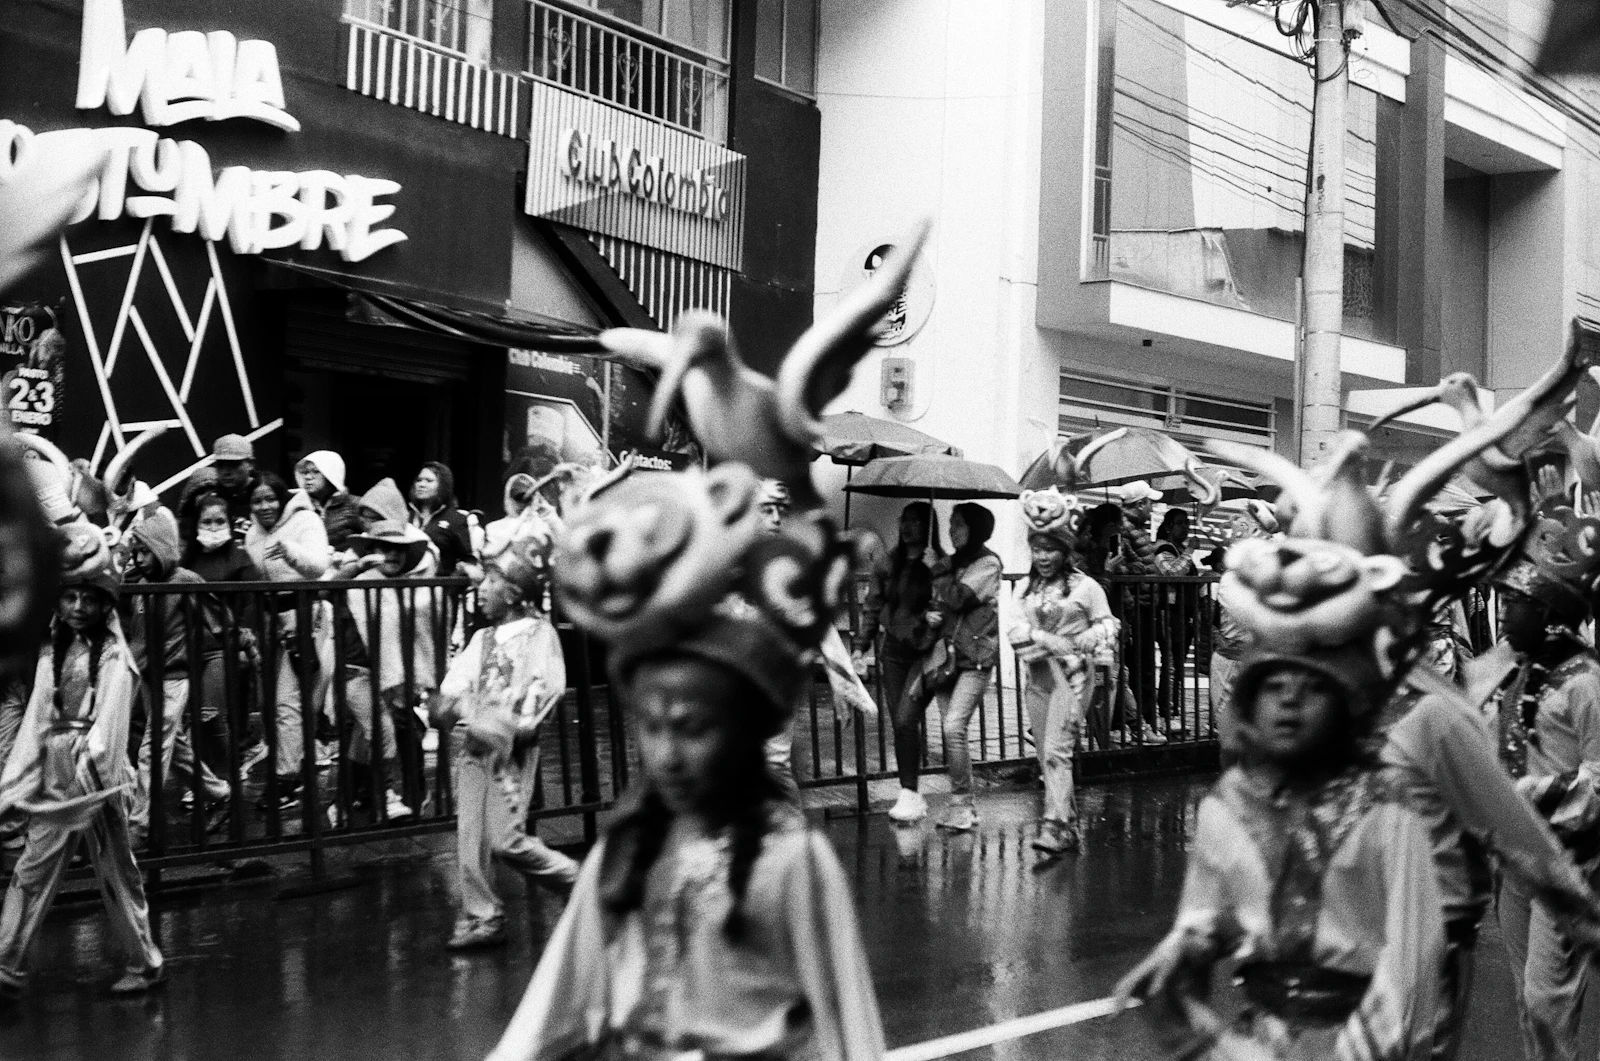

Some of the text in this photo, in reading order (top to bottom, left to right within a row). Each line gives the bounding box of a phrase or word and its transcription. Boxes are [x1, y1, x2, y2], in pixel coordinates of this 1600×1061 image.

[0, 118, 408, 262] OTUMBRE
[11, 410, 52, 425] ENERO
[619, 449, 672, 470] Cntactos:
